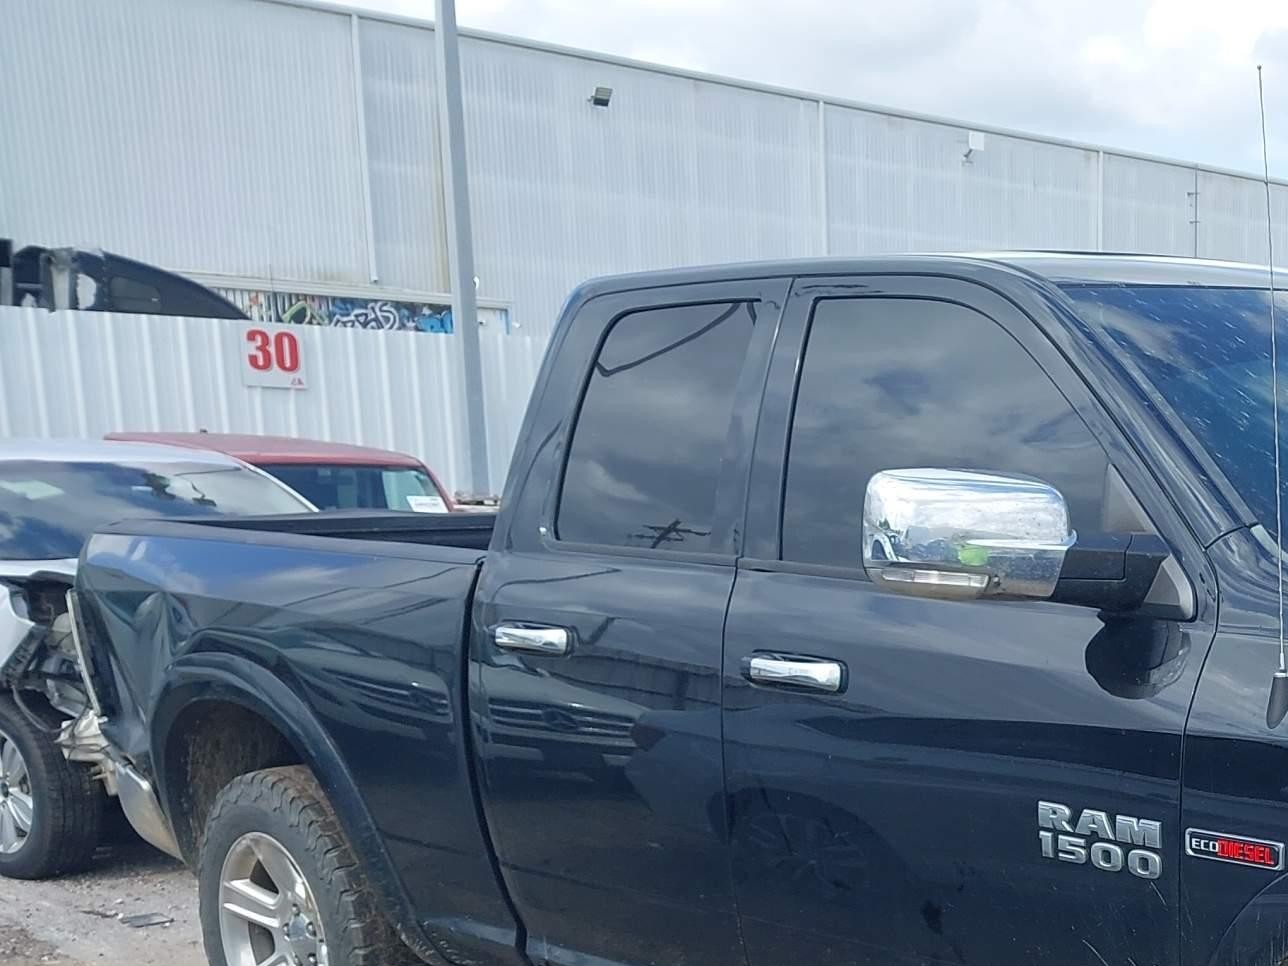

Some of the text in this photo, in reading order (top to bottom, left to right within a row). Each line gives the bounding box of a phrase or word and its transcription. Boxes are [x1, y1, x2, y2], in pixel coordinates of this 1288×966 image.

[246, 329, 299, 373] 30
[1038, 800, 1162, 849] RAM
[1038, 830, 1163, 880] 1500
[1191, 836, 1275, 866] ECODIESEL
